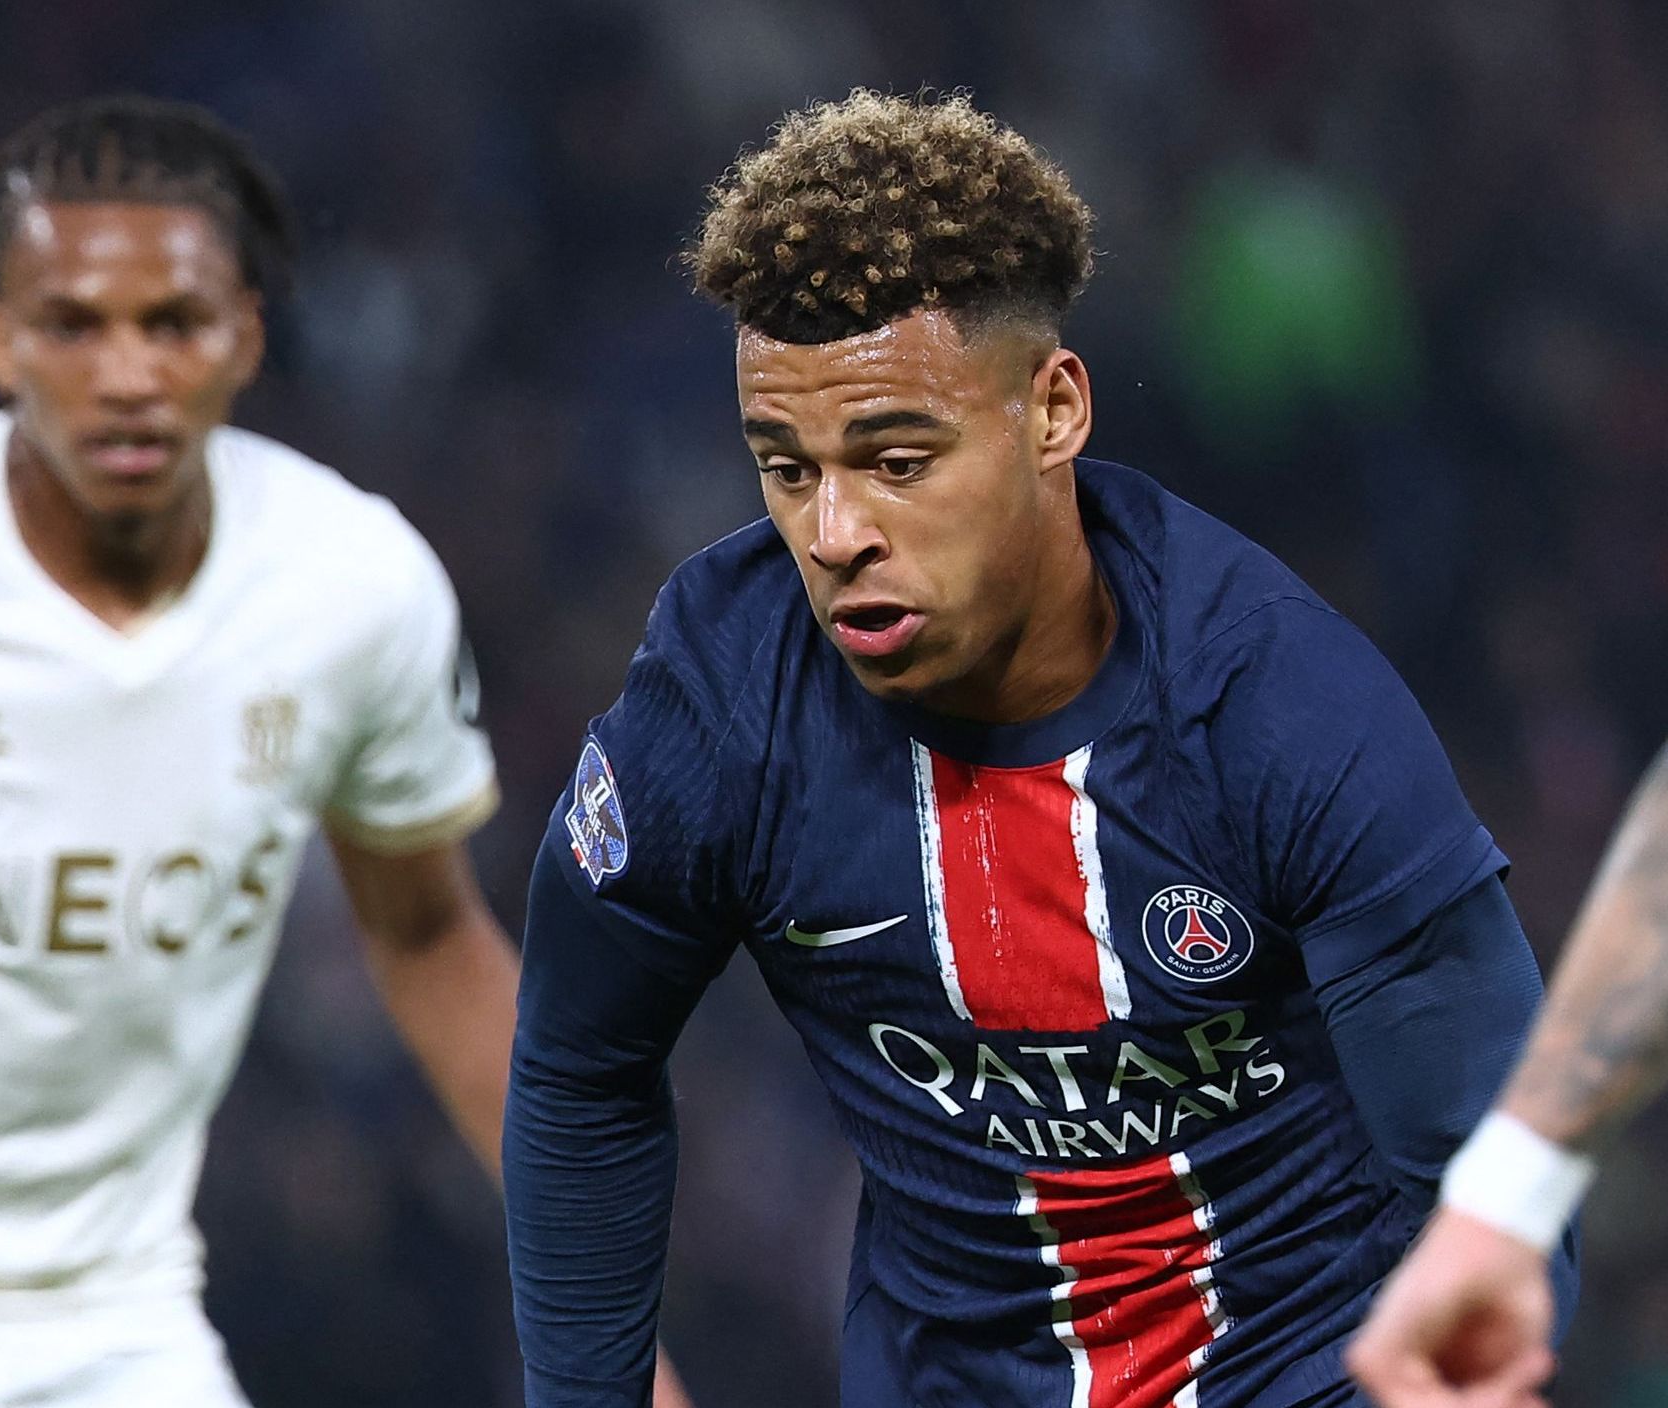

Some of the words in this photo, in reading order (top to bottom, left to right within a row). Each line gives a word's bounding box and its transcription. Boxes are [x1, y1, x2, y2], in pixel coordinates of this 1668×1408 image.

[1156, 889, 1226, 915] PARIS
[868, 1009, 1264, 1118] QATAR
[985, 1047, 1287, 1160] AIRWAYS
